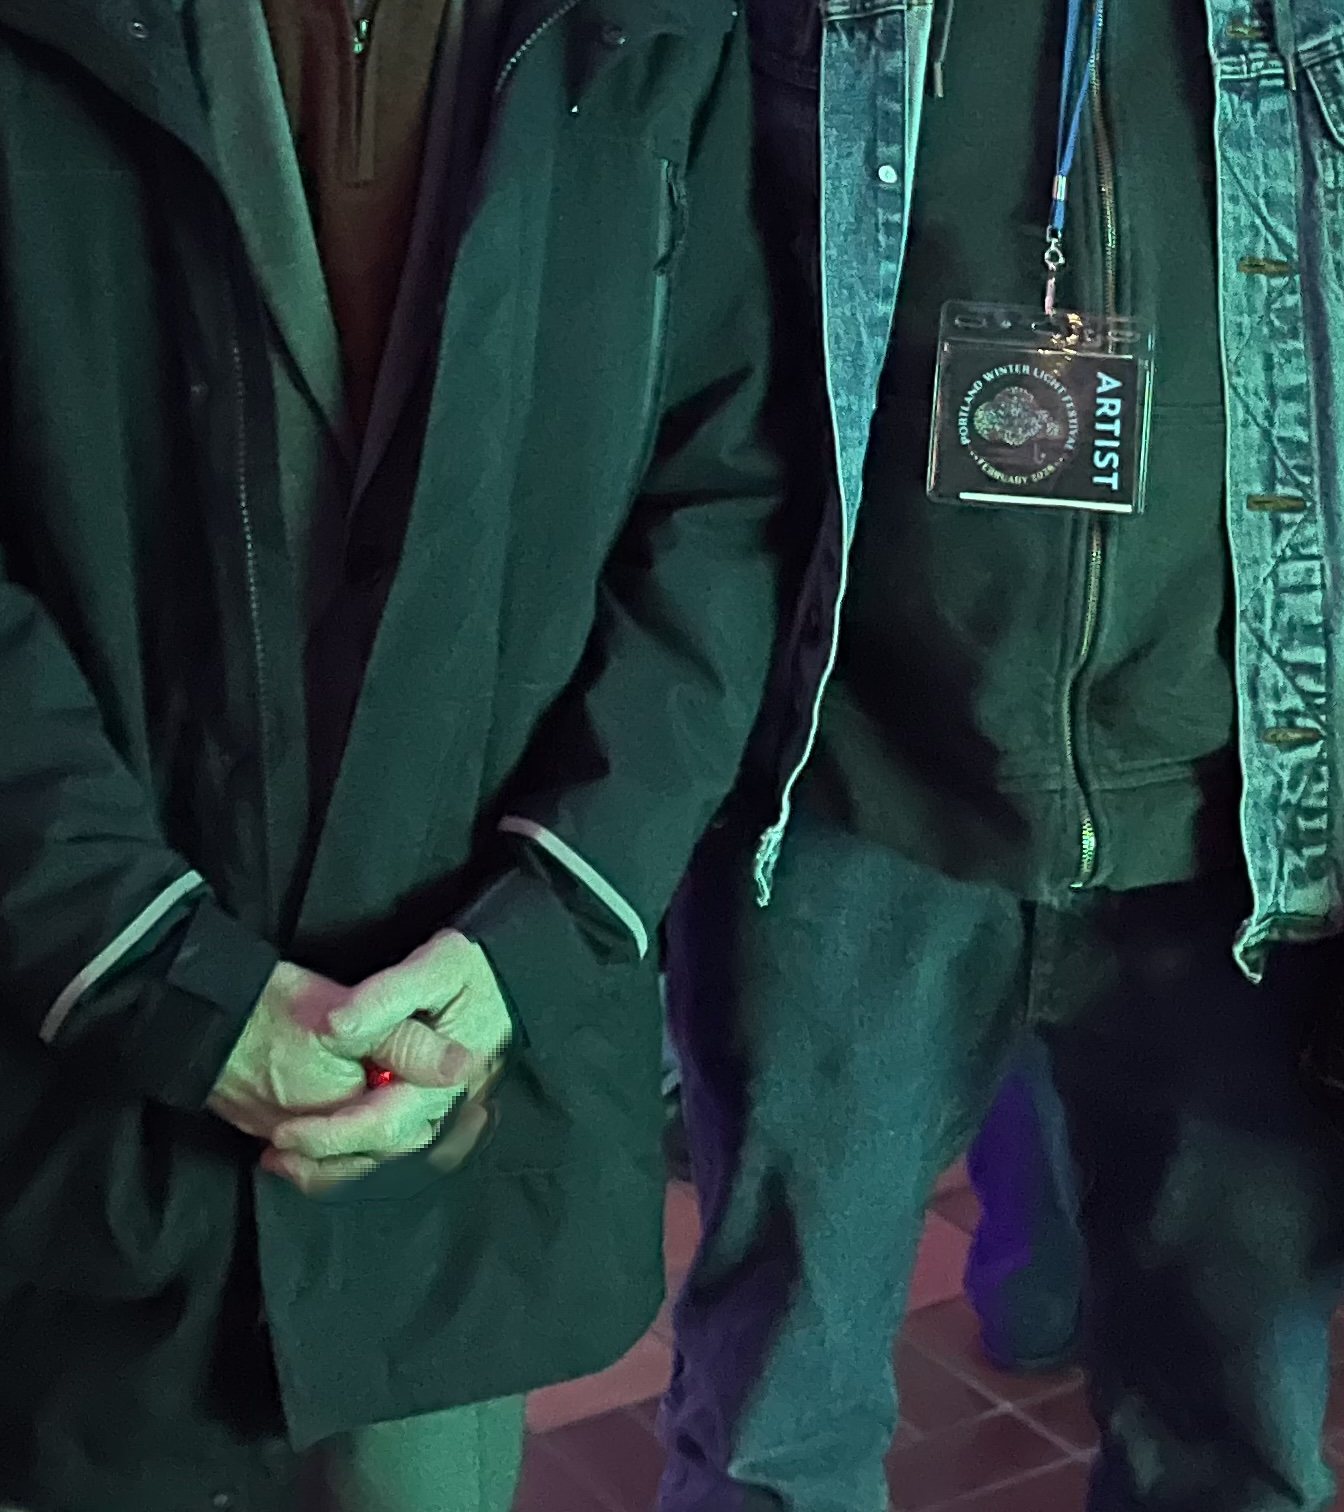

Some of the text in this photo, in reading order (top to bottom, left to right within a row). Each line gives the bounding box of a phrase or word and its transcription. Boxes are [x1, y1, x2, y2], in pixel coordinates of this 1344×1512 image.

[958, 363, 1080, 450] PORTLAND WINTER LIGHT FESTIVAL
[1092, 371, 1123, 491] ARTIST
